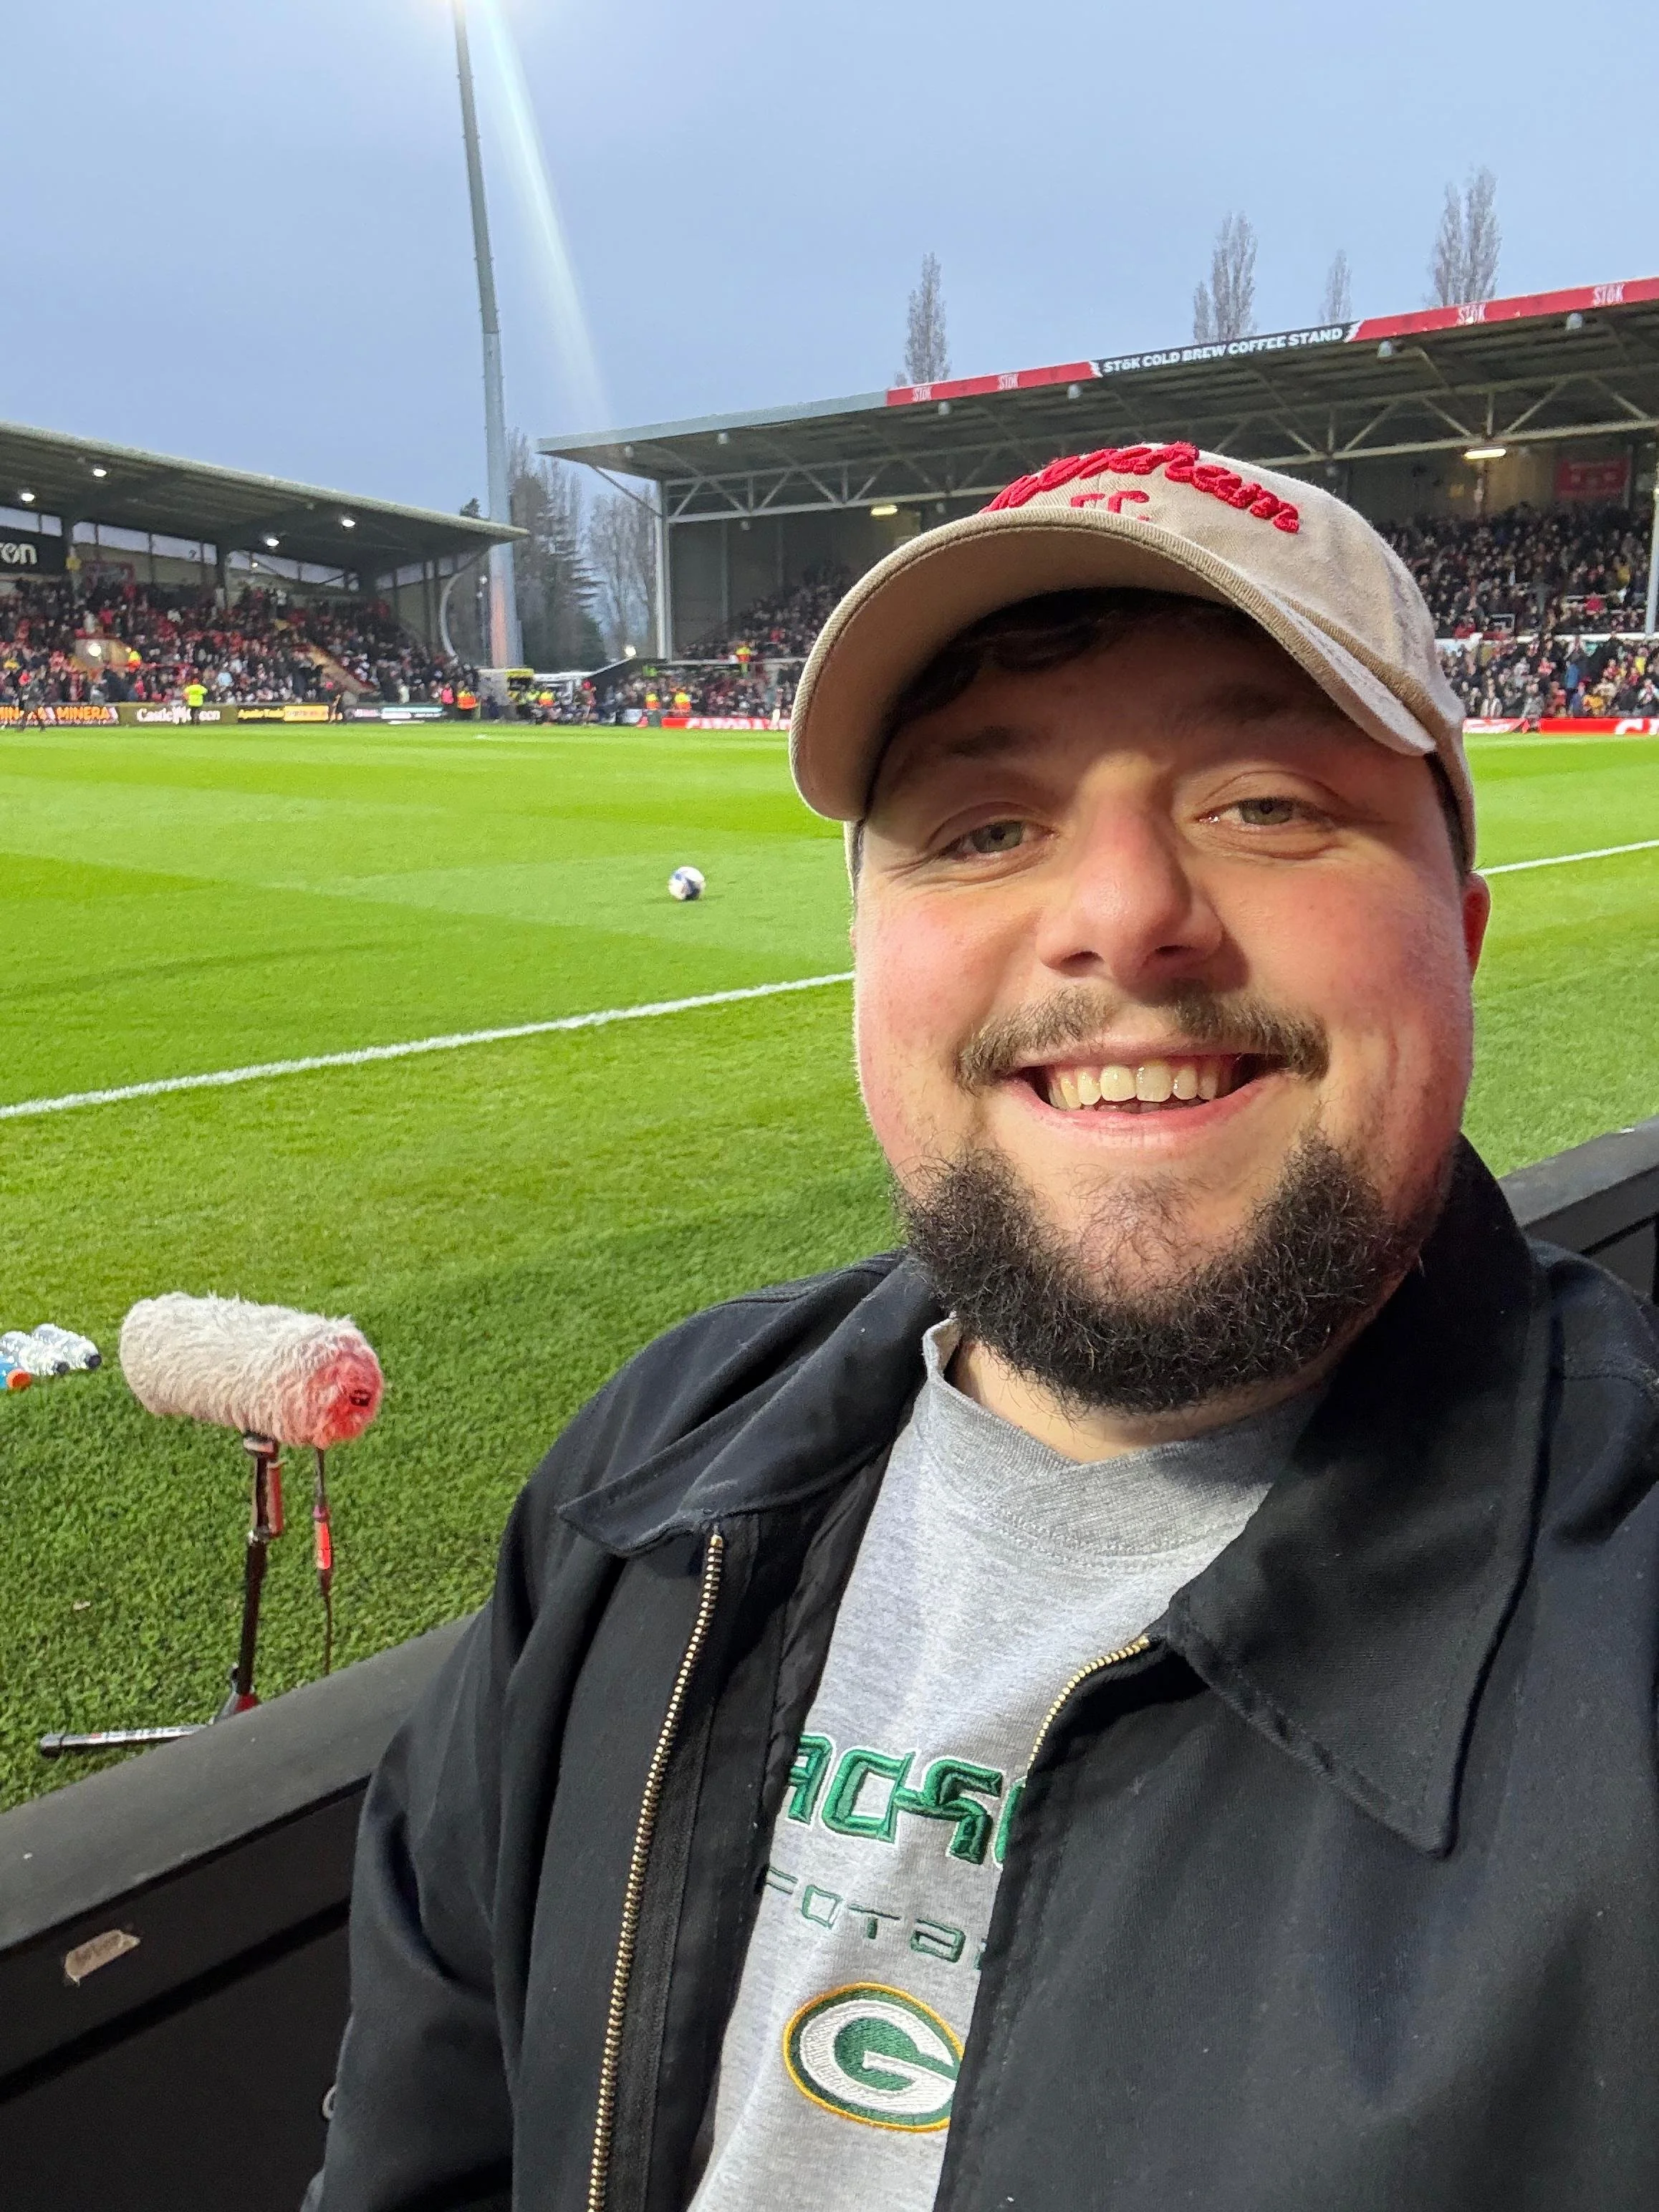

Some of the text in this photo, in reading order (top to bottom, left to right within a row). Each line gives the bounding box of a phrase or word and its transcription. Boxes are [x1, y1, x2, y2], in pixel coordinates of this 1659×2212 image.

[1142, 351, 1181, 367] COLD
[1182, 344, 1227, 362] BREW
[1227, 335, 1287, 355] COFFEE
[1289, 327, 1343, 347] STAND
[799, 1999, 958, 2115] G
